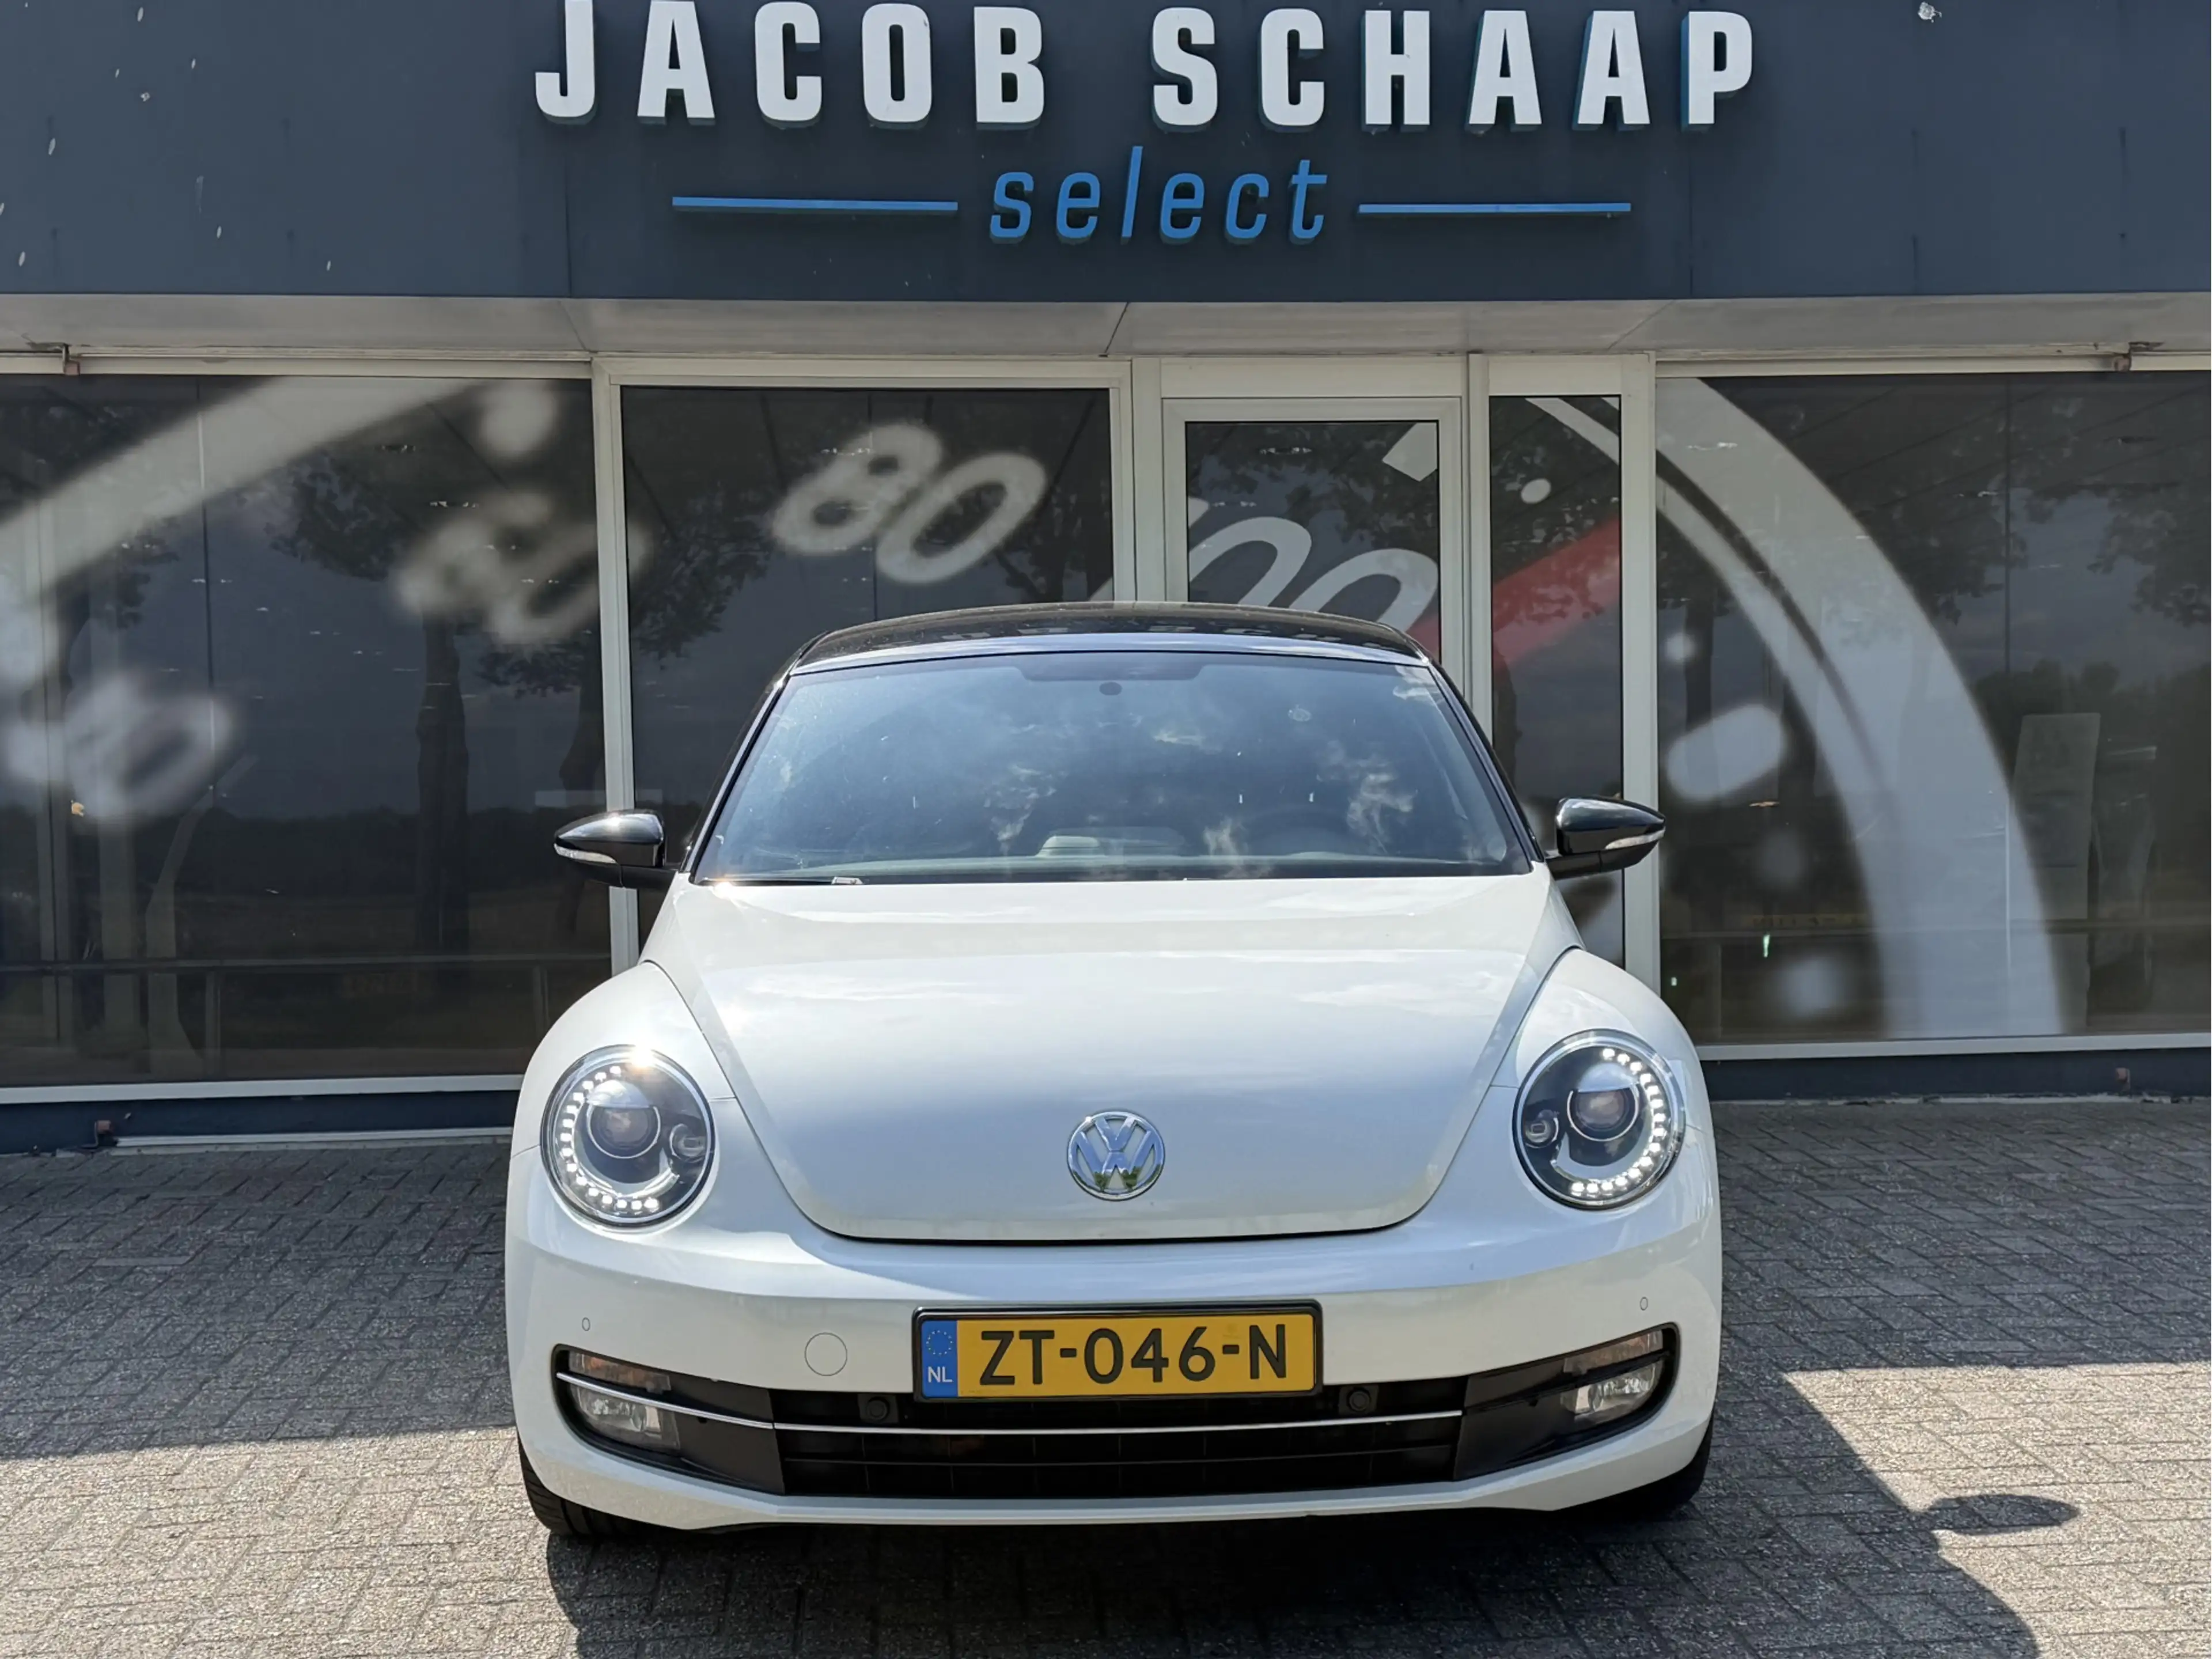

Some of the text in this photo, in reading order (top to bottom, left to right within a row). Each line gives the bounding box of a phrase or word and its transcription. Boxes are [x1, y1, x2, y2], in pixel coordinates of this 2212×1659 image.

[536, 0, 1752, 126] JACOB SCHAAP
[990, 146, 1327, 239] select
[771, 419, 1047, 584] 80
[1070, 1112, 1162, 1198] VW
[927, 1366, 953, 1384] NL
[979, 1324, 1287, 1385] ZT-046-N
